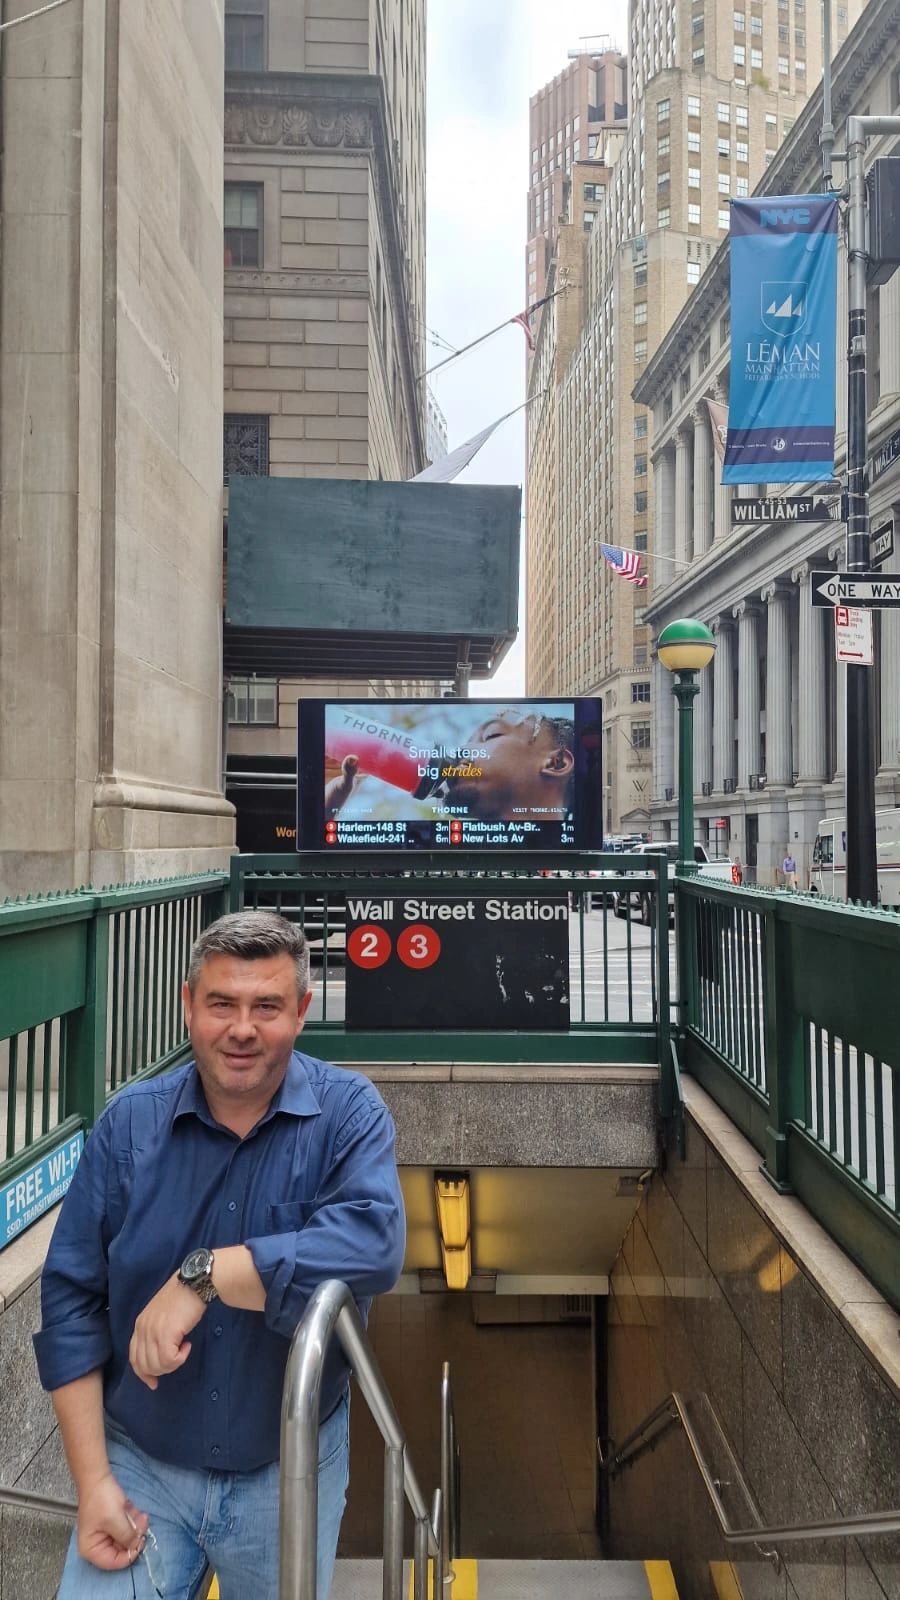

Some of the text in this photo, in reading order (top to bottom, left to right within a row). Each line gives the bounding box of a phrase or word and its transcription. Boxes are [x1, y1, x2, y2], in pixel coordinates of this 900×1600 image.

[760, 208, 810, 227] NYC
[746, 339, 821, 364] LÉMAN
[875, 446, 895, 474] WALL
[734, 503, 811, 521] WILLIAM ST
[875, 532, 890, 554] WAY
[827, 583, 900, 598] ONE WAY
[343, 714, 413, 749] THORNE
[409, 745, 491, 761] Small steps,
[417, 763, 483, 780] big strides
[431, 806, 469, 814] THORNE
[337, 822, 393, 832] Harlem-148
[396, 822, 407, 832] St
[435, 823, 449, 832] 3m
[462, 822, 505, 832] Flatbush
[561, 822, 574, 832] 1m
[337, 834, 405, 844] Wakefield-241
[435, 834, 449, 844] 6m
[462, 834, 484, 843] New
[486, 834, 508, 843] Lots
[511, 834, 524, 843] Av
[560, 834, 574, 843] 3m
[348, 899, 568, 921] Wall Street Station
[6, 1139, 81, 1221] FREE WI-FI
